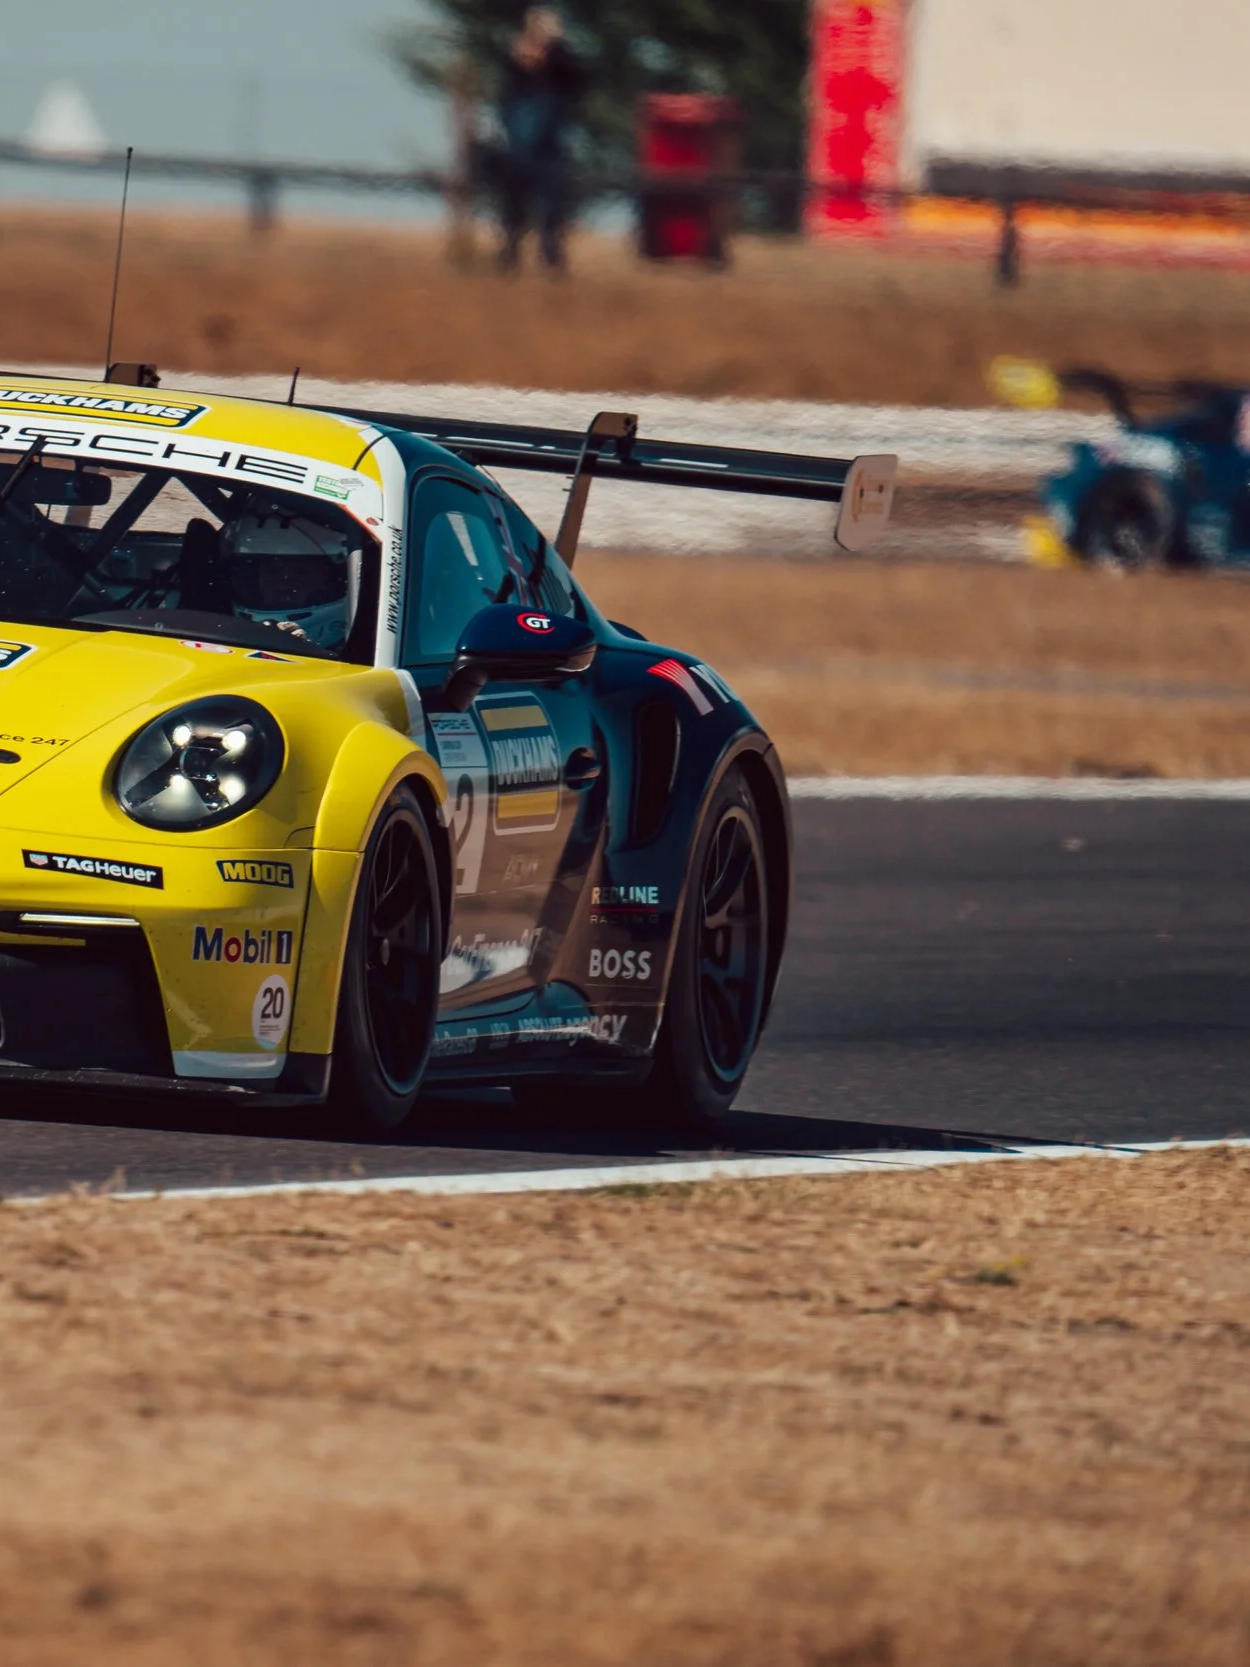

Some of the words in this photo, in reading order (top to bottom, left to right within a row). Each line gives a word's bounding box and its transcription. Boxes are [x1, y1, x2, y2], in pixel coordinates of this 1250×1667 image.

[386, 524, 403, 635] www.porsche.co.uk
[526, 617, 551, 629] GT
[30, 735, 70, 747] 247
[223, 863, 290, 885] MOOG
[591, 886, 659, 905] REDLINE
[192, 925, 272, 964] Mobil
[278, 931, 291, 964] 1
[588, 948, 652, 980] BOSS
[260, 986, 285, 1020] 20
